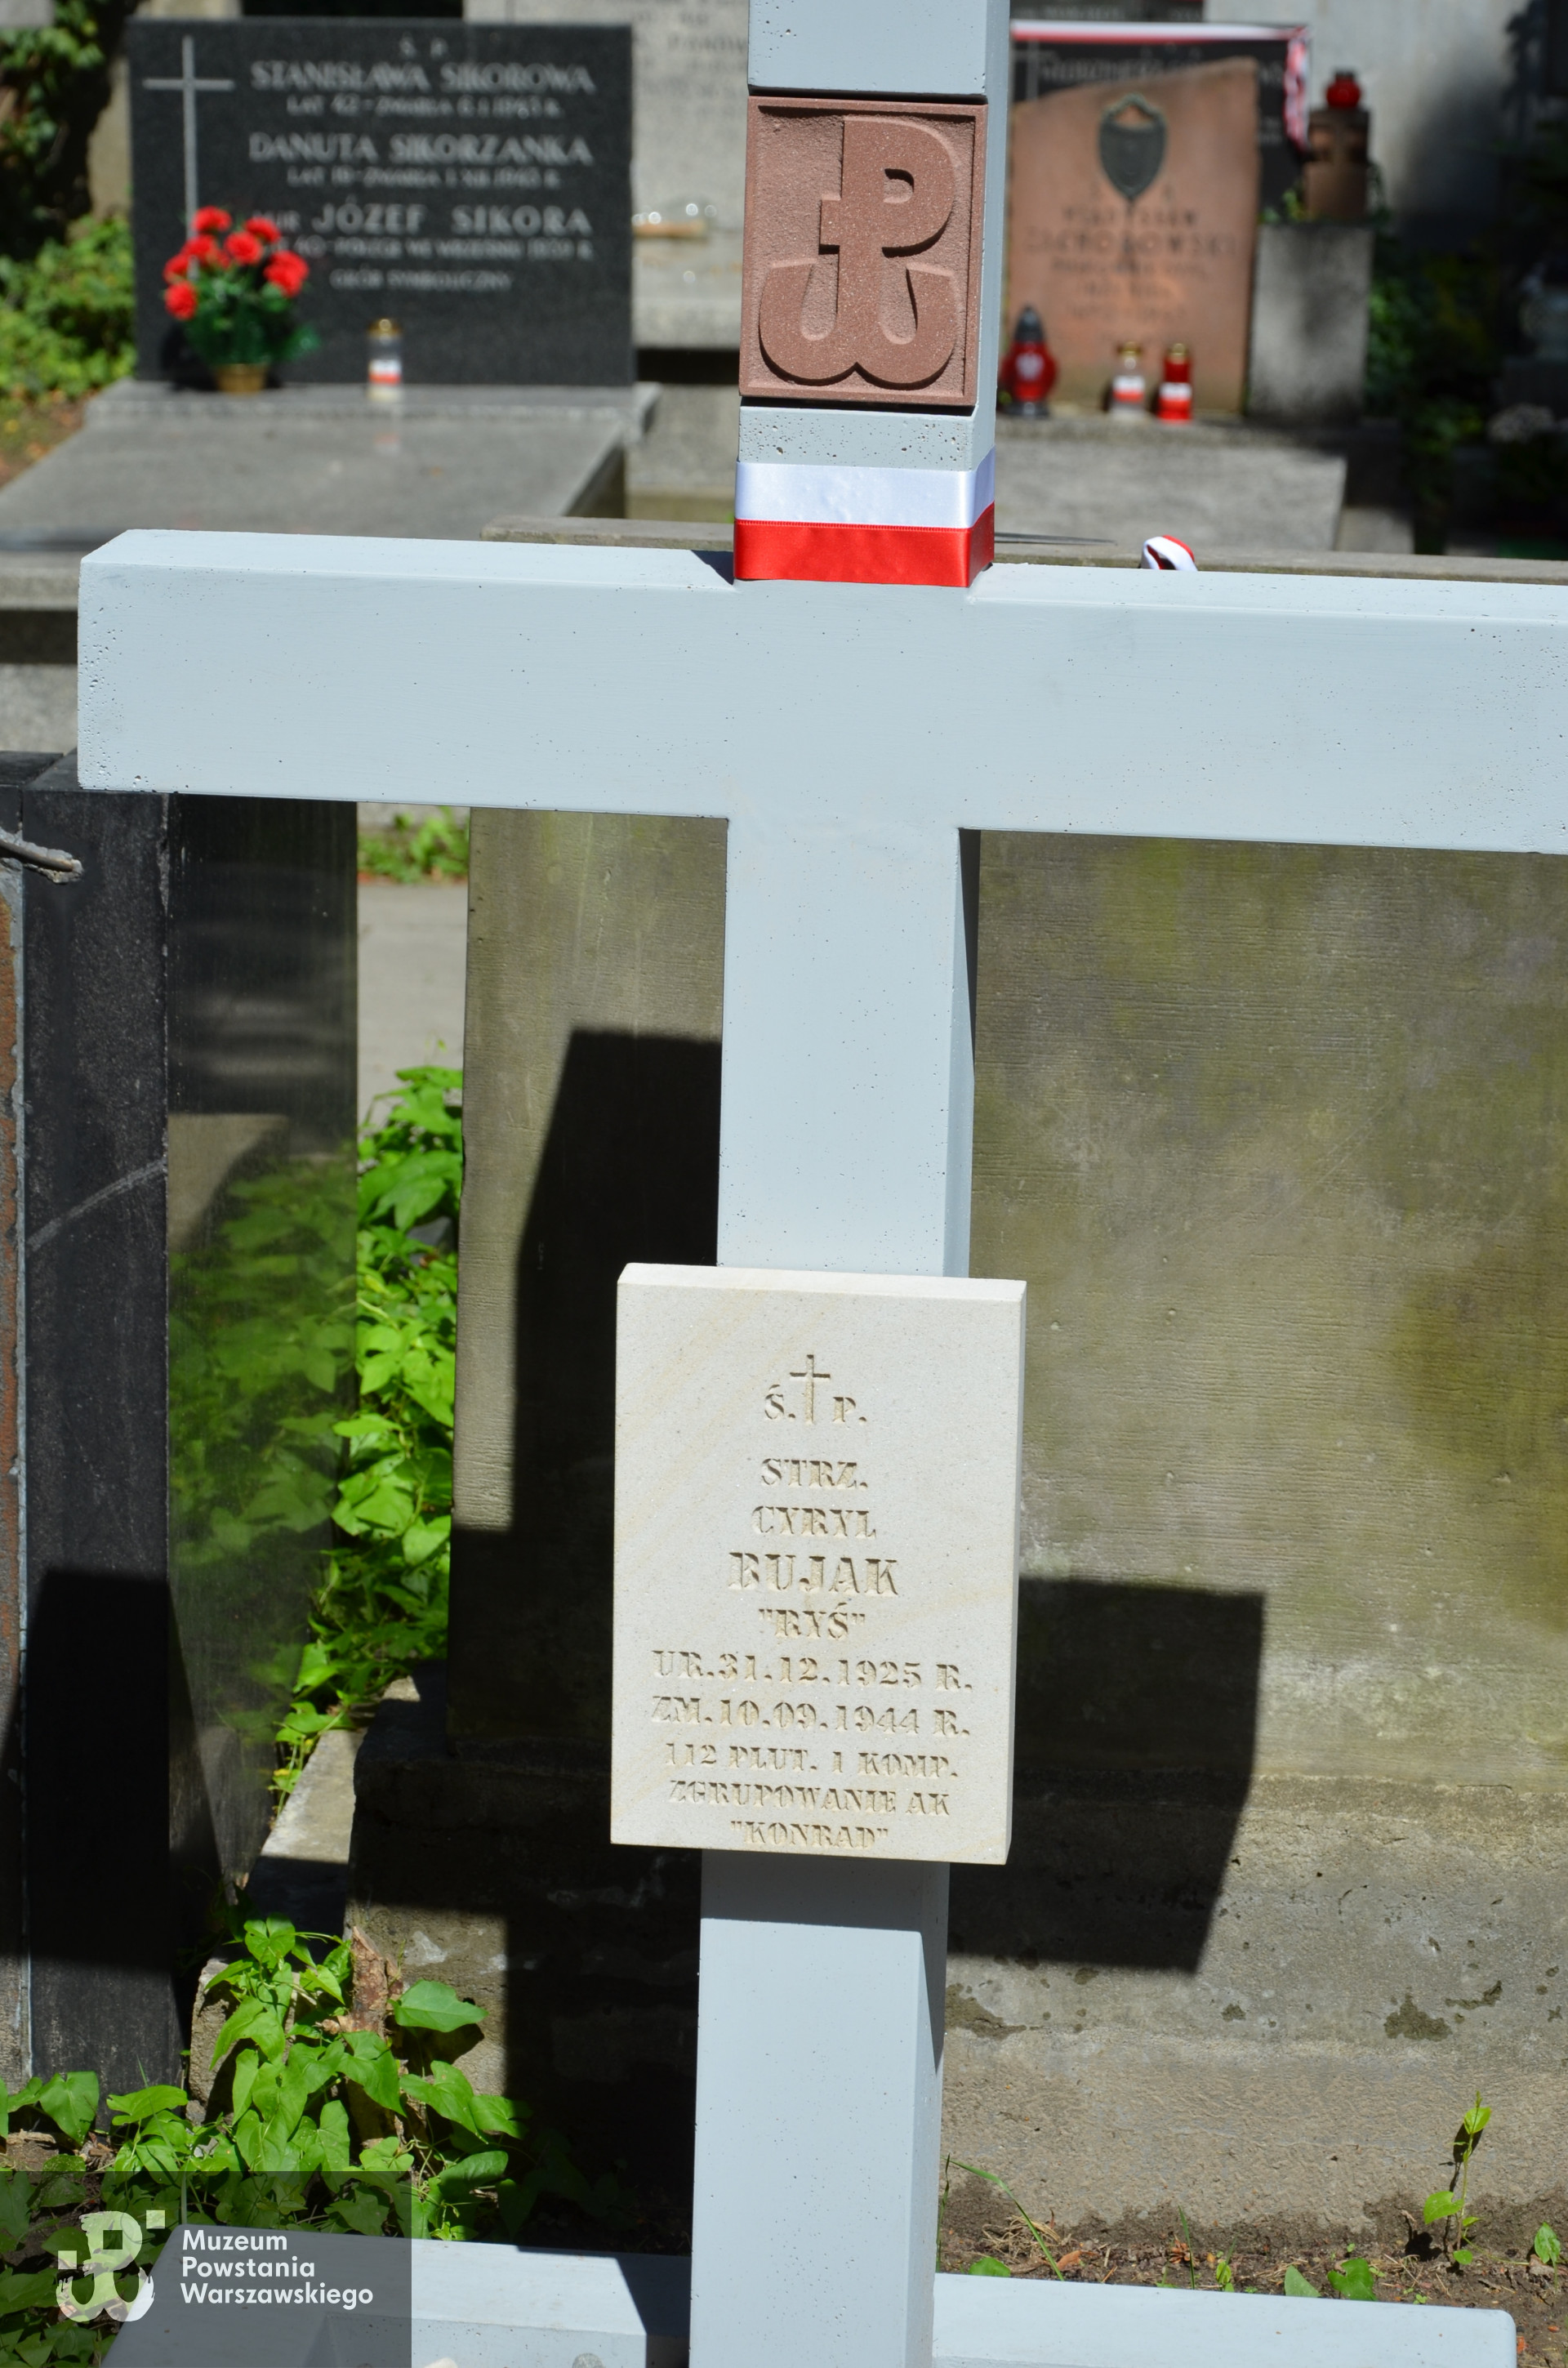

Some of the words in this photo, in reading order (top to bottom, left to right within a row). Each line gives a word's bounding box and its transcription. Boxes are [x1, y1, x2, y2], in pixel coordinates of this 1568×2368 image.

[441, 62, 596, 94] SIKOROWA
[248, 132, 379, 163] DANUTA
[389, 133, 595, 165] SIKORZANKA
[311, 194, 428, 234] JÓZEF
[451, 205, 594, 237] SIKORA
[764, 1384, 796, 1420] Ś.
[832, 1396, 867, 1424] P.
[761, 1458, 868, 1489] STRZ.
[751, 1505, 876, 1539] CYRYL
[727, 1551, 898, 1596] BUJAK
[935, 1663, 973, 1692] R.
[933, 1709, 970, 1737] R.
[665, 1742, 718, 1766] 112
[728, 1746, 818, 1773] PLUT.
[858, 1752, 958, 1779] KOMP.
[669, 1779, 897, 1813] ZGRUPOWANIE
[906, 1792, 950, 1816] AK
[730, 1821, 889, 1849] "KONRAD"
